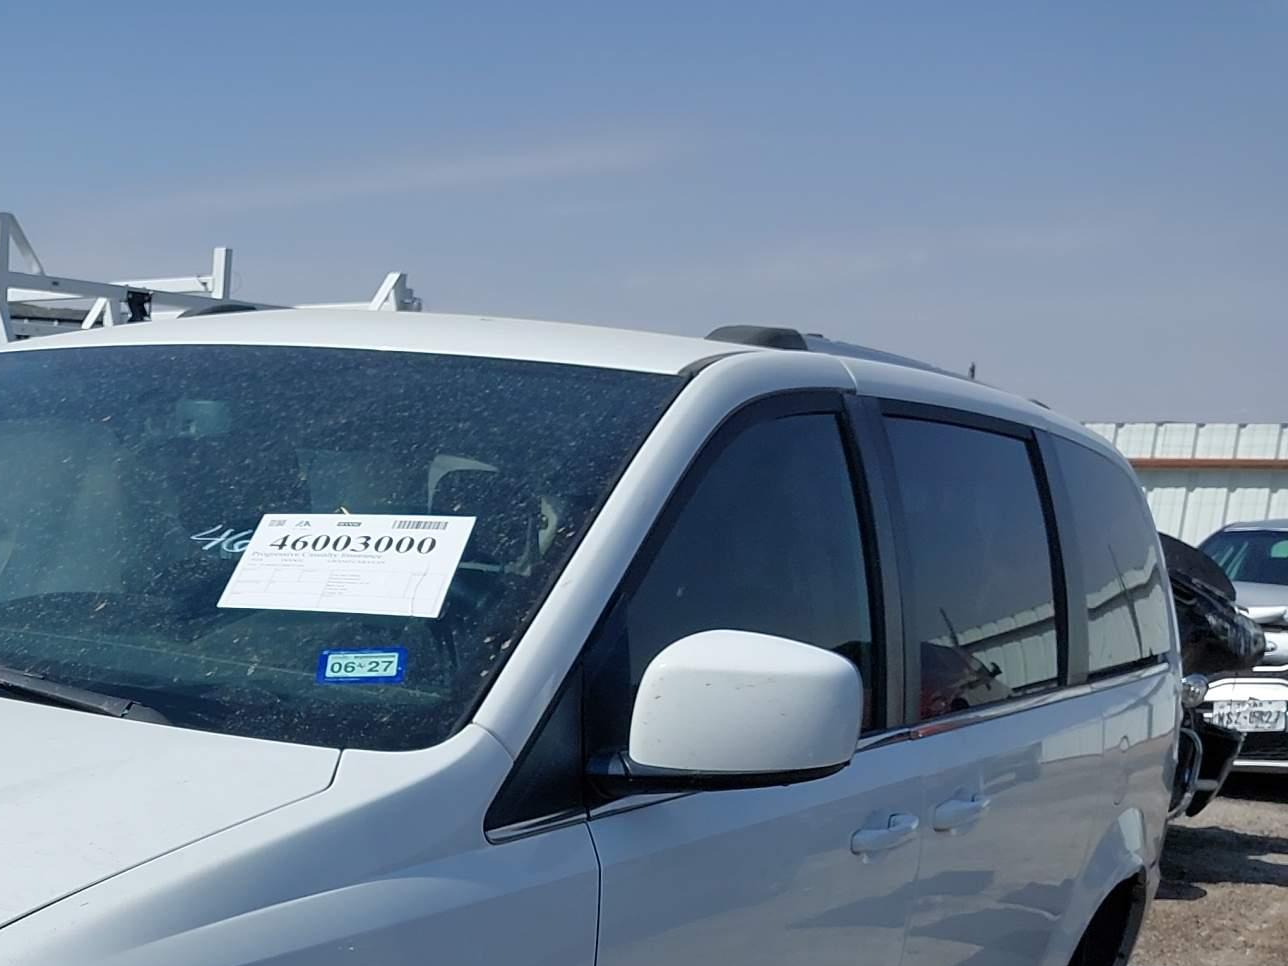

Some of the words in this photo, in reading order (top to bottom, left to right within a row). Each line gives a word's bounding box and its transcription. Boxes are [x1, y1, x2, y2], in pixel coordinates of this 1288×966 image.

[269, 534, 438, 555] 46003000
[330, 661, 356, 674] 06
[367, 660, 394, 673] 27
